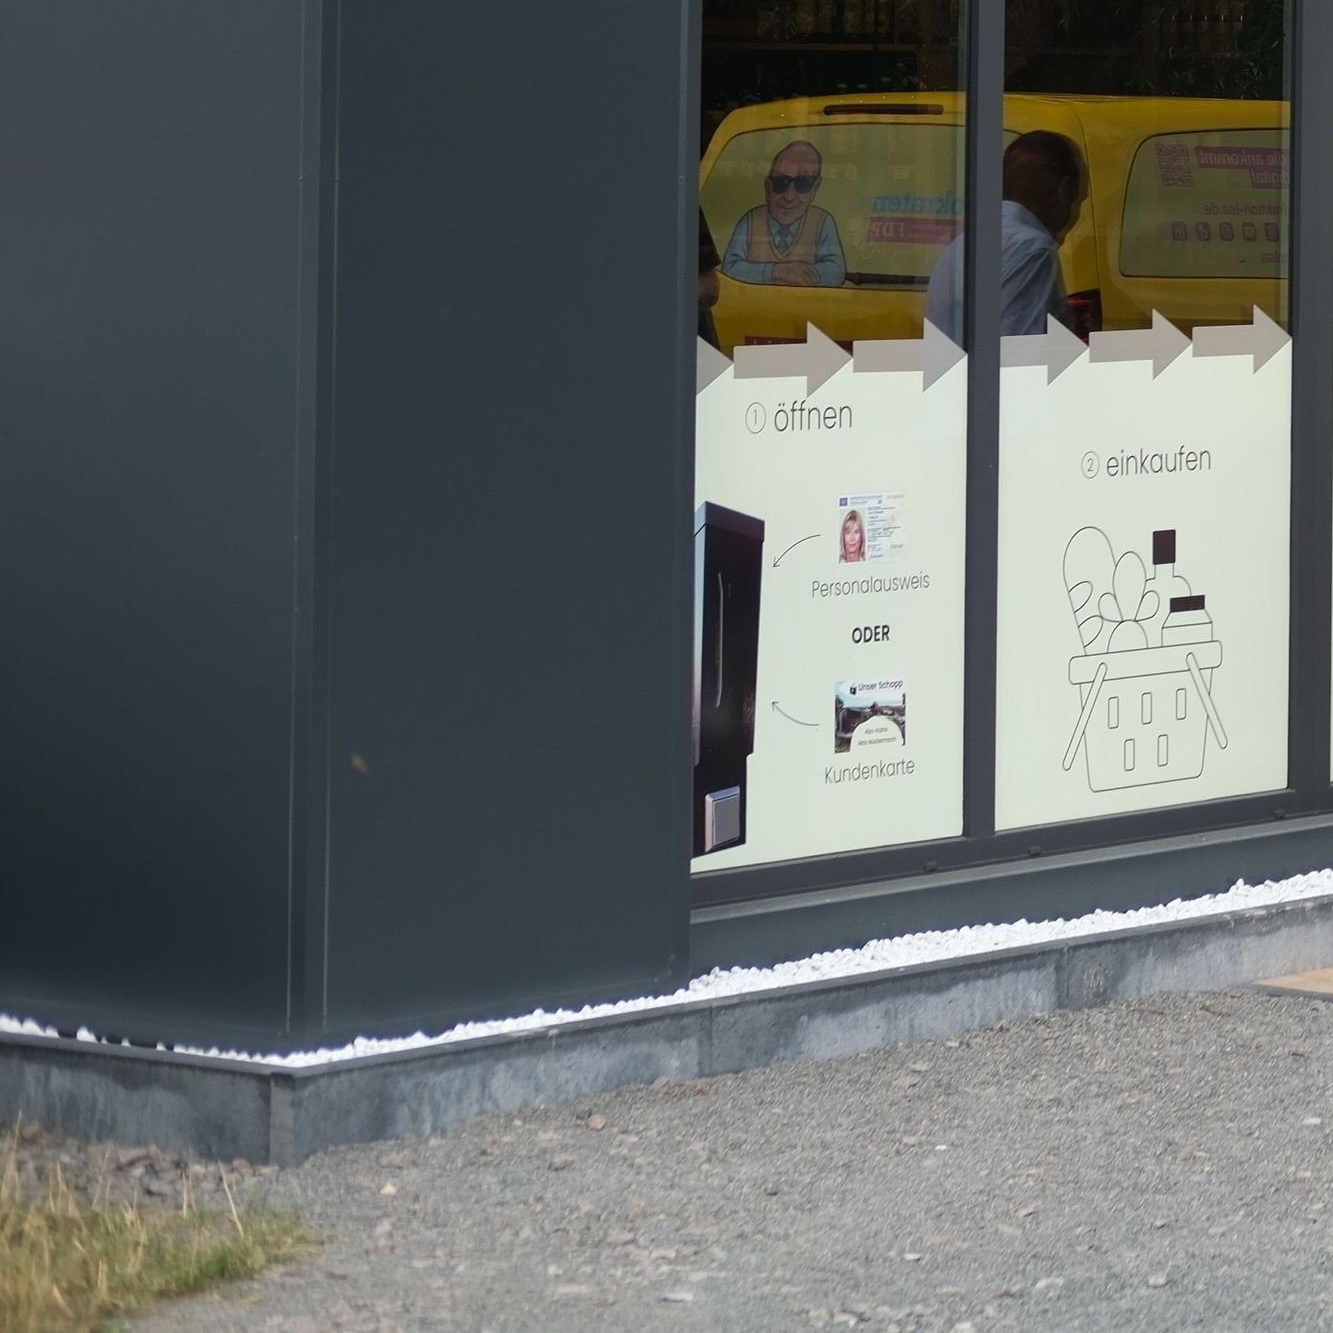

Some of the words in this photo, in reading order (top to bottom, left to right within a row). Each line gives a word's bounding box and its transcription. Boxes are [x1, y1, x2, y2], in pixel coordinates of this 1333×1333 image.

[774, 399, 852, 432] öffnen
[1106, 444, 1211, 477] einkaufen
[811, 571, 930, 598] Personalausweis
[851, 624, 890, 644] ODER
[824, 759, 915, 785] Kundenkarte
